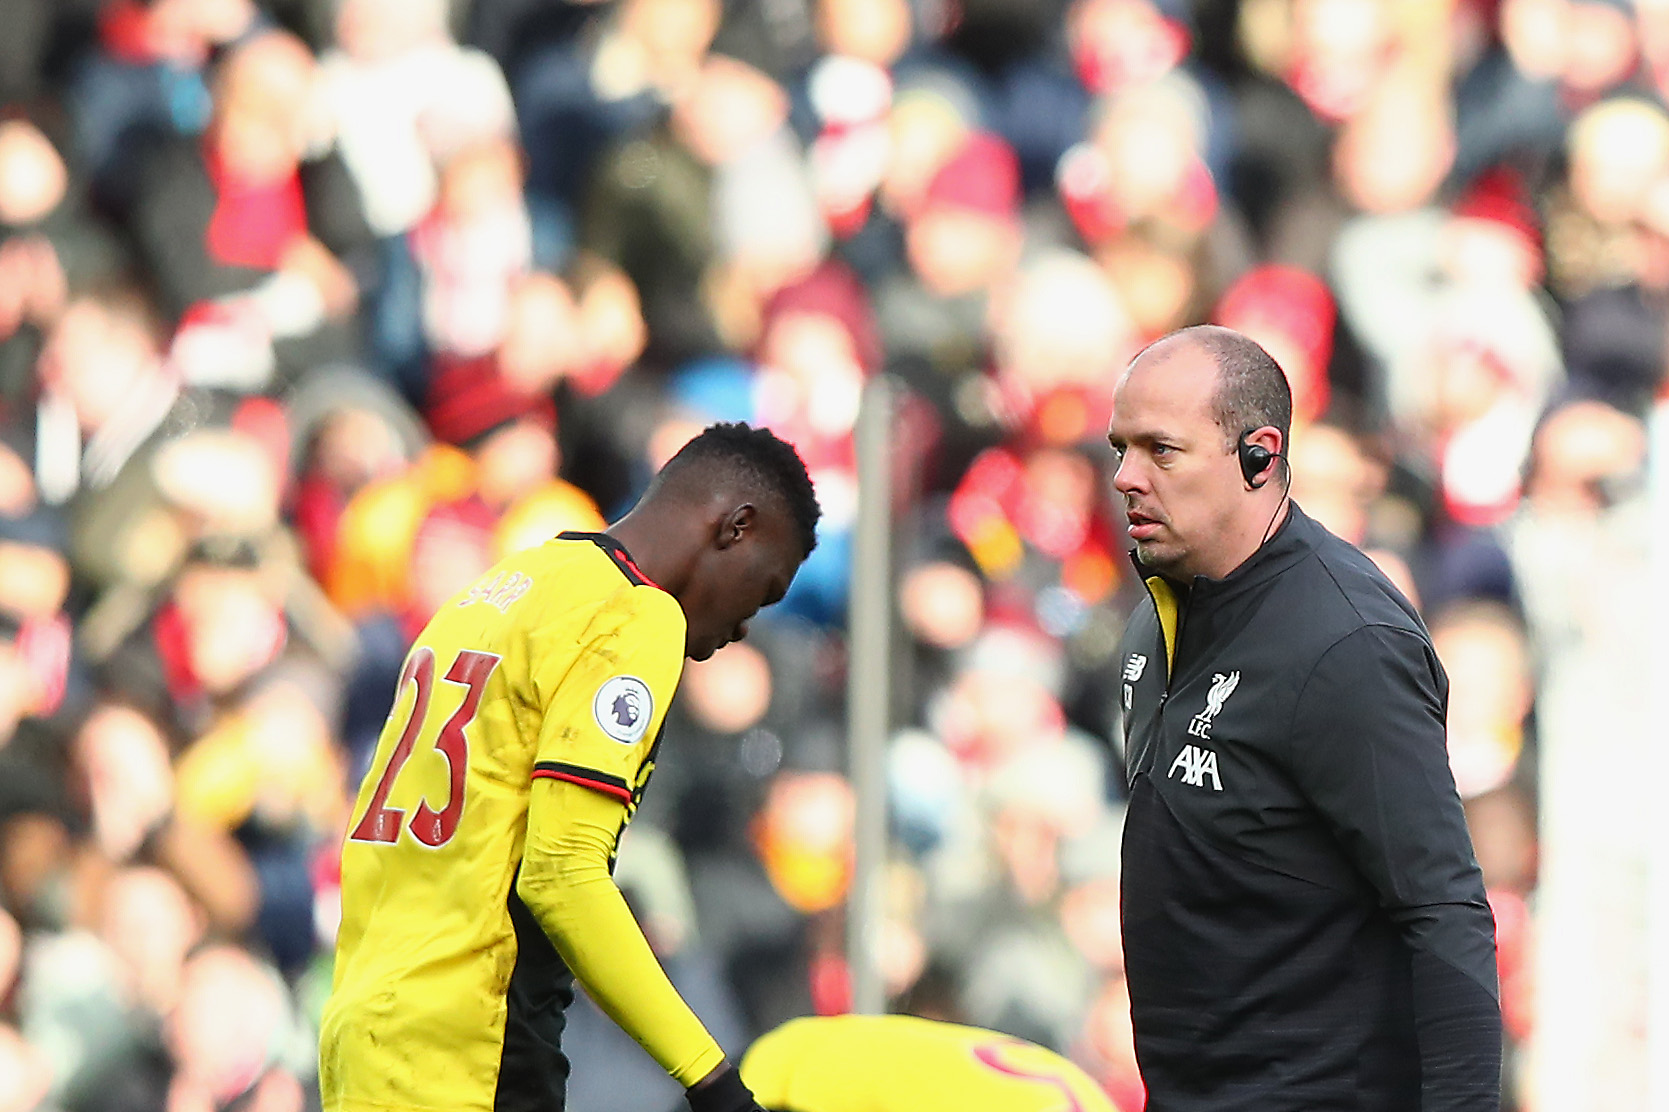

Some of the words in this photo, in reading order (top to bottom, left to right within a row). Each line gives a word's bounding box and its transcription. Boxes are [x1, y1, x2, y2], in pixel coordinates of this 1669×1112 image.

[457, 570, 534, 614] SARR
[350, 646, 503, 849] 23
[1167, 745, 1224, 791] AXA
